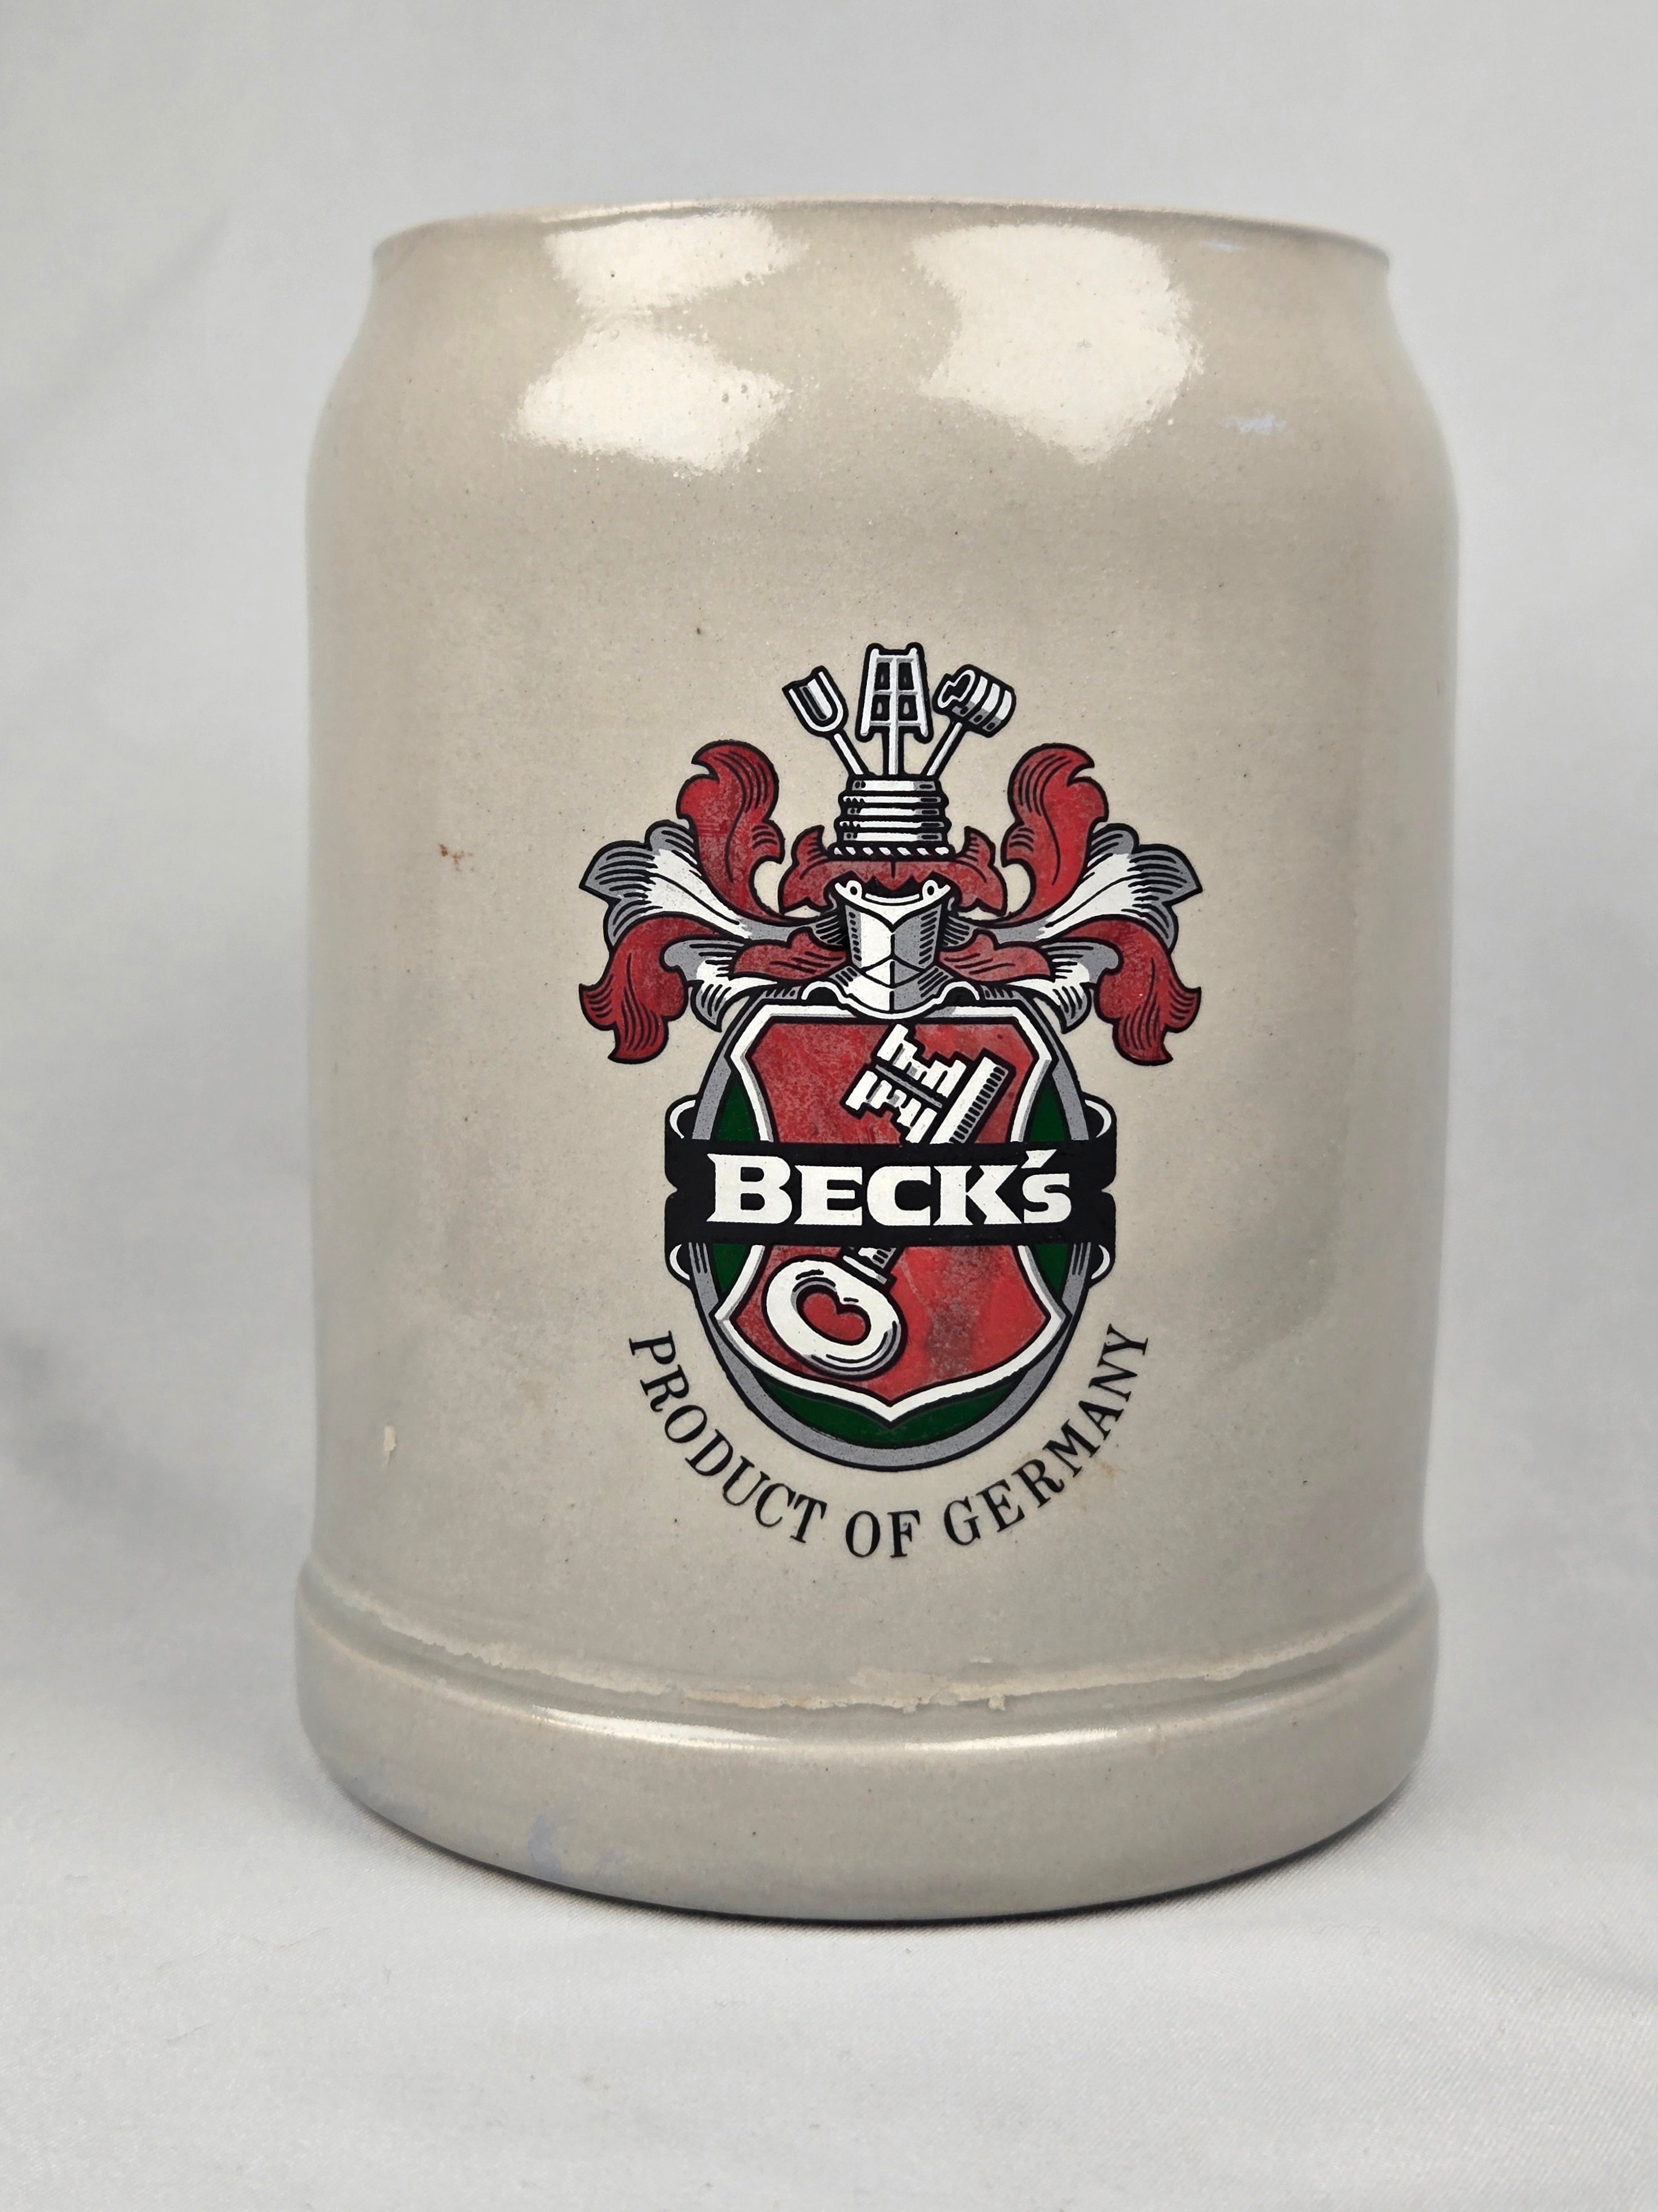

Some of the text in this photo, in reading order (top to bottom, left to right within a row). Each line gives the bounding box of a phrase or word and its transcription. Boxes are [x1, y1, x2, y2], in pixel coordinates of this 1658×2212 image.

[628, 1323, 1149, 1559] PRODUCT OF GERMANY
